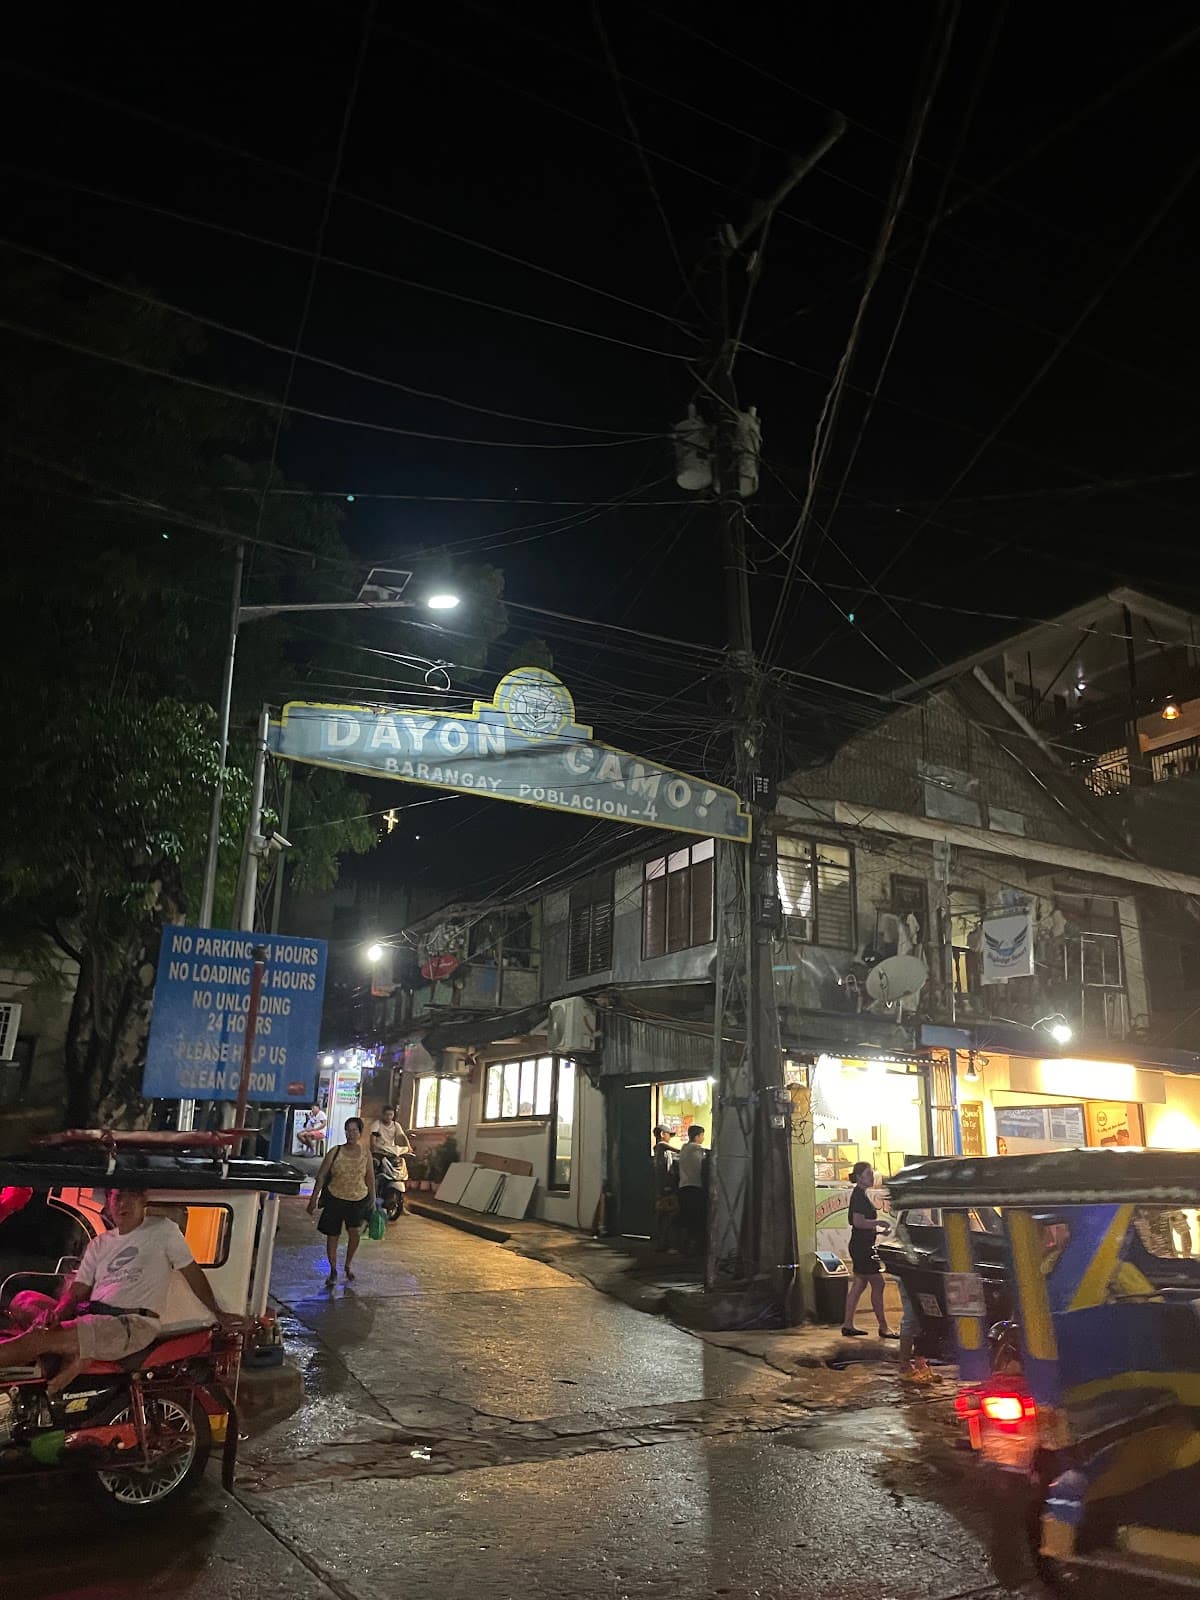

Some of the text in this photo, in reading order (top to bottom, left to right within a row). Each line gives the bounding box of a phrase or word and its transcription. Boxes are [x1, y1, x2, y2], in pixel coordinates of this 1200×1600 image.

[327, 714, 506, 755] DAYON
[385, 757, 658, 820] BARANGAY POBLACION-4
[172, 935, 192, 954] NO
[195, 937, 253, 959] PARKING
[275, 945, 318, 965] HOURS
[168, 962, 189, 981] NO
[192, 963, 250, 985] LOADING
[272, 970, 316, 991] HOURS
[193, 990, 291, 1015] NO UNLODING
[207, 1013, 272, 1035] 24 HORS
[174, 1040, 287, 1065] PLEASE HLP US
[229, 1072, 276, 1092] CRON
